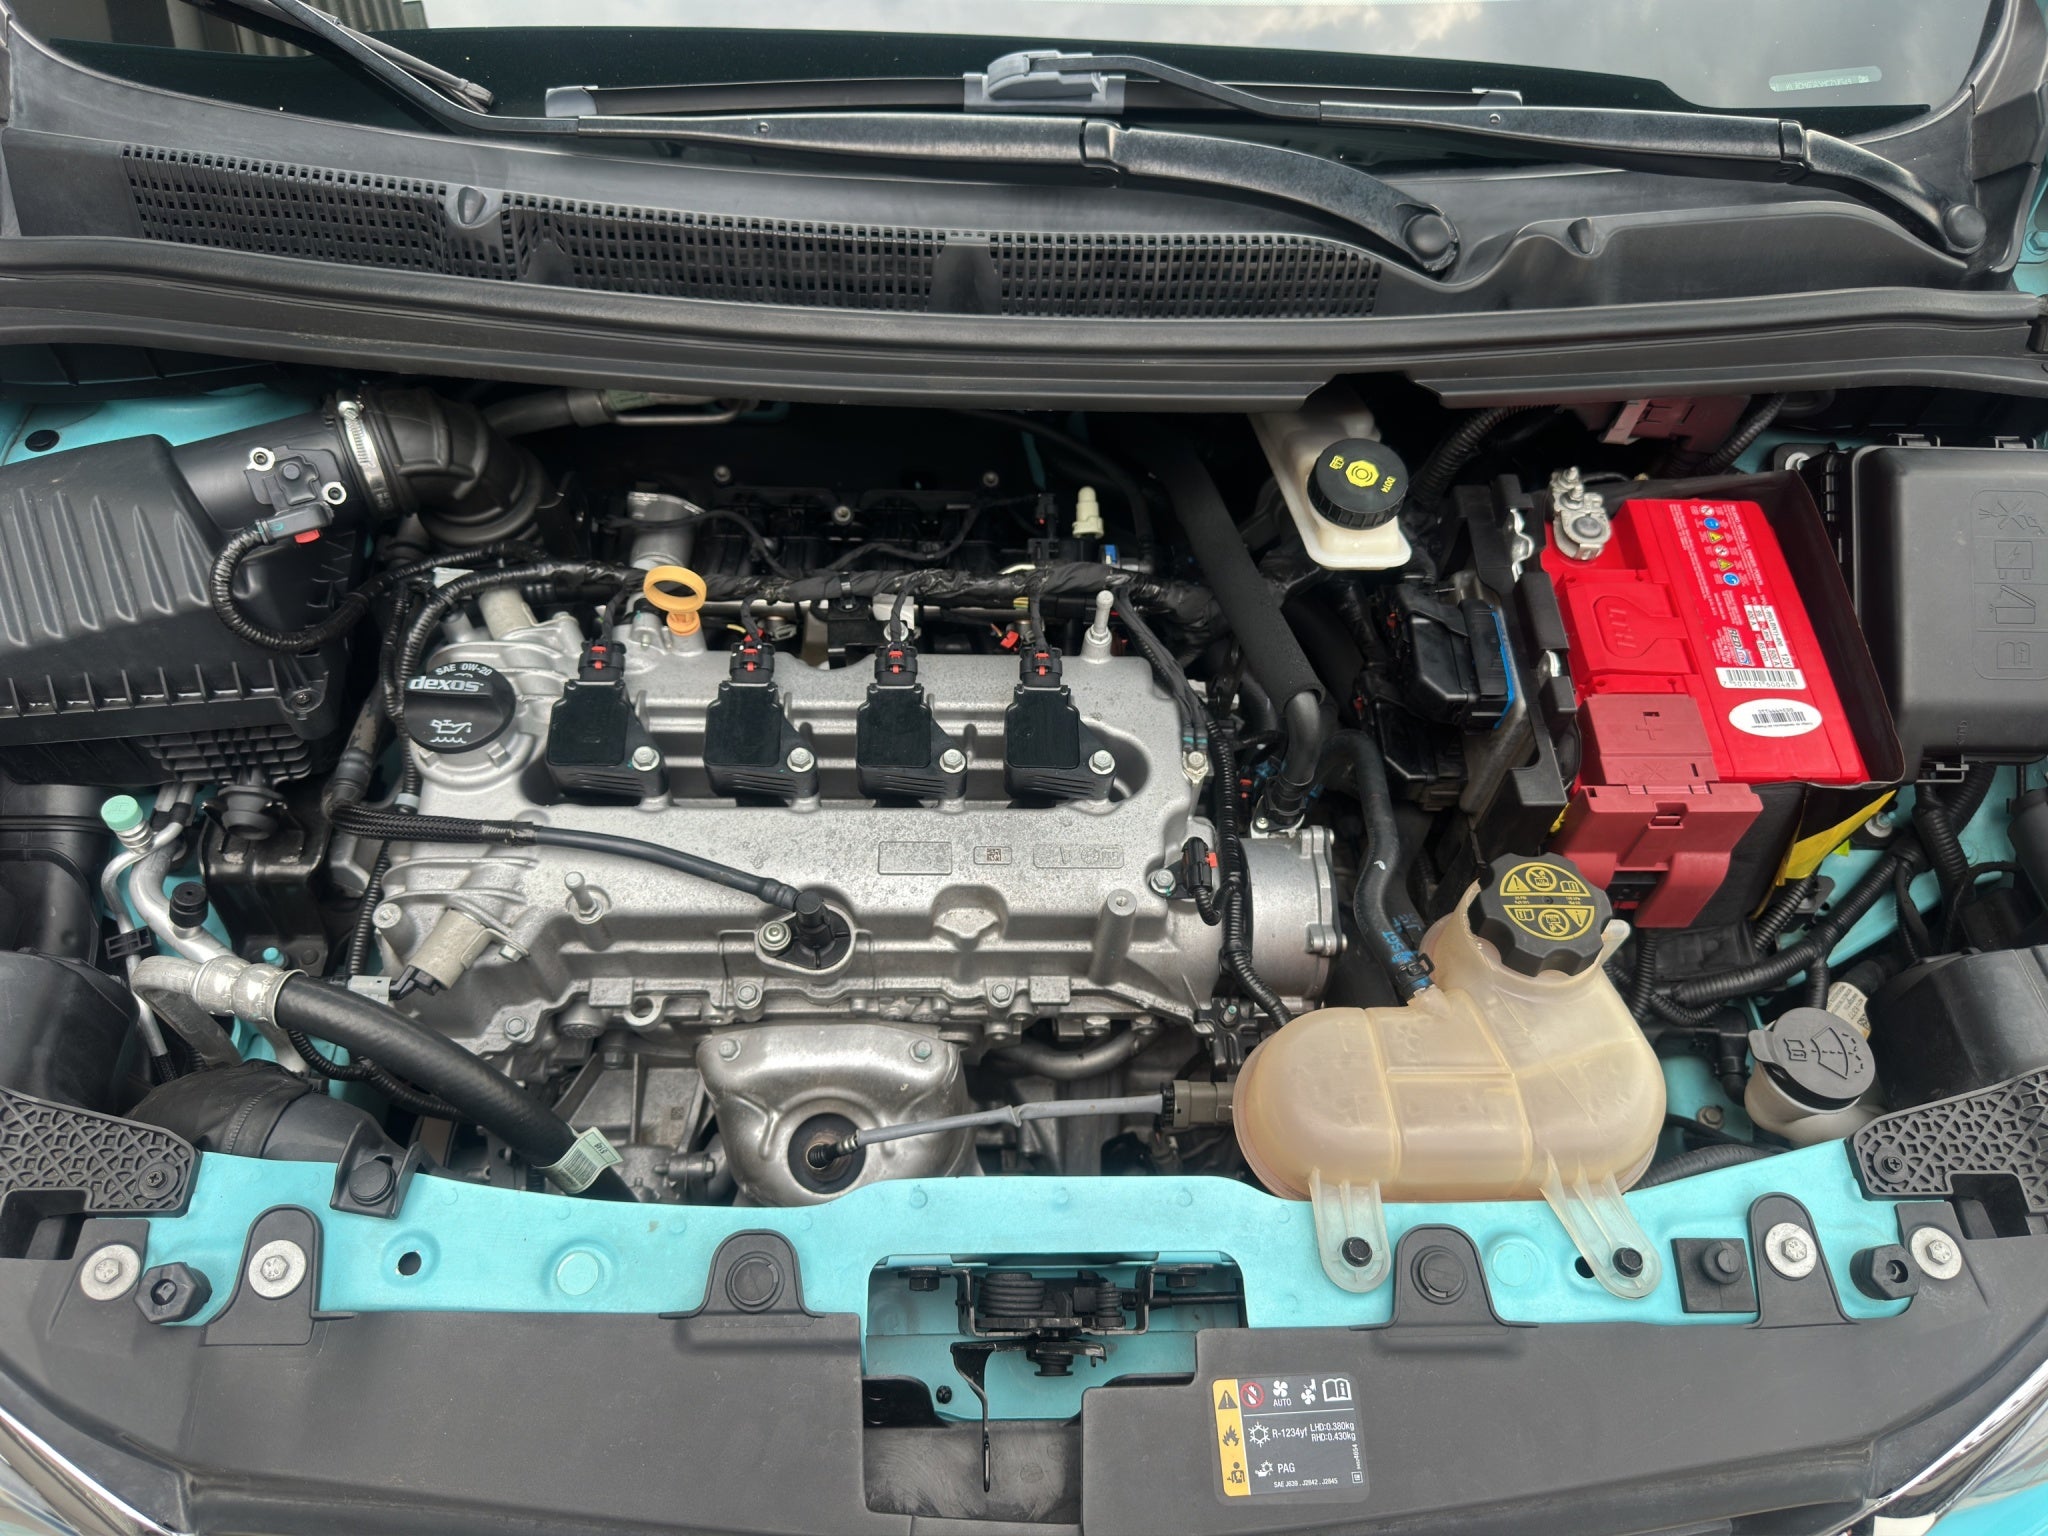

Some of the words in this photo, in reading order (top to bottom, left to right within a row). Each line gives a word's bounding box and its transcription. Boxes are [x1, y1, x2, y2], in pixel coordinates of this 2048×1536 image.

[1381, 476, 1396, 493] DOT4
[1781, 653, 1792, 667] 12V
[435, 664, 457, 676] SAE
[461, 663, 493, 676] 0W-20
[409, 676, 480, 692] dexos
[1273, 1398, 1292, 1407] AUTO
[1310, 1422, 1355, 1431] LHD:0.380kg
[1272, 1427, 1308, 1438] R-1234yf
[1311, 1432, 1356, 1442] RHD:0.430kg
[1277, 1463, 1296, 1473] PAG
